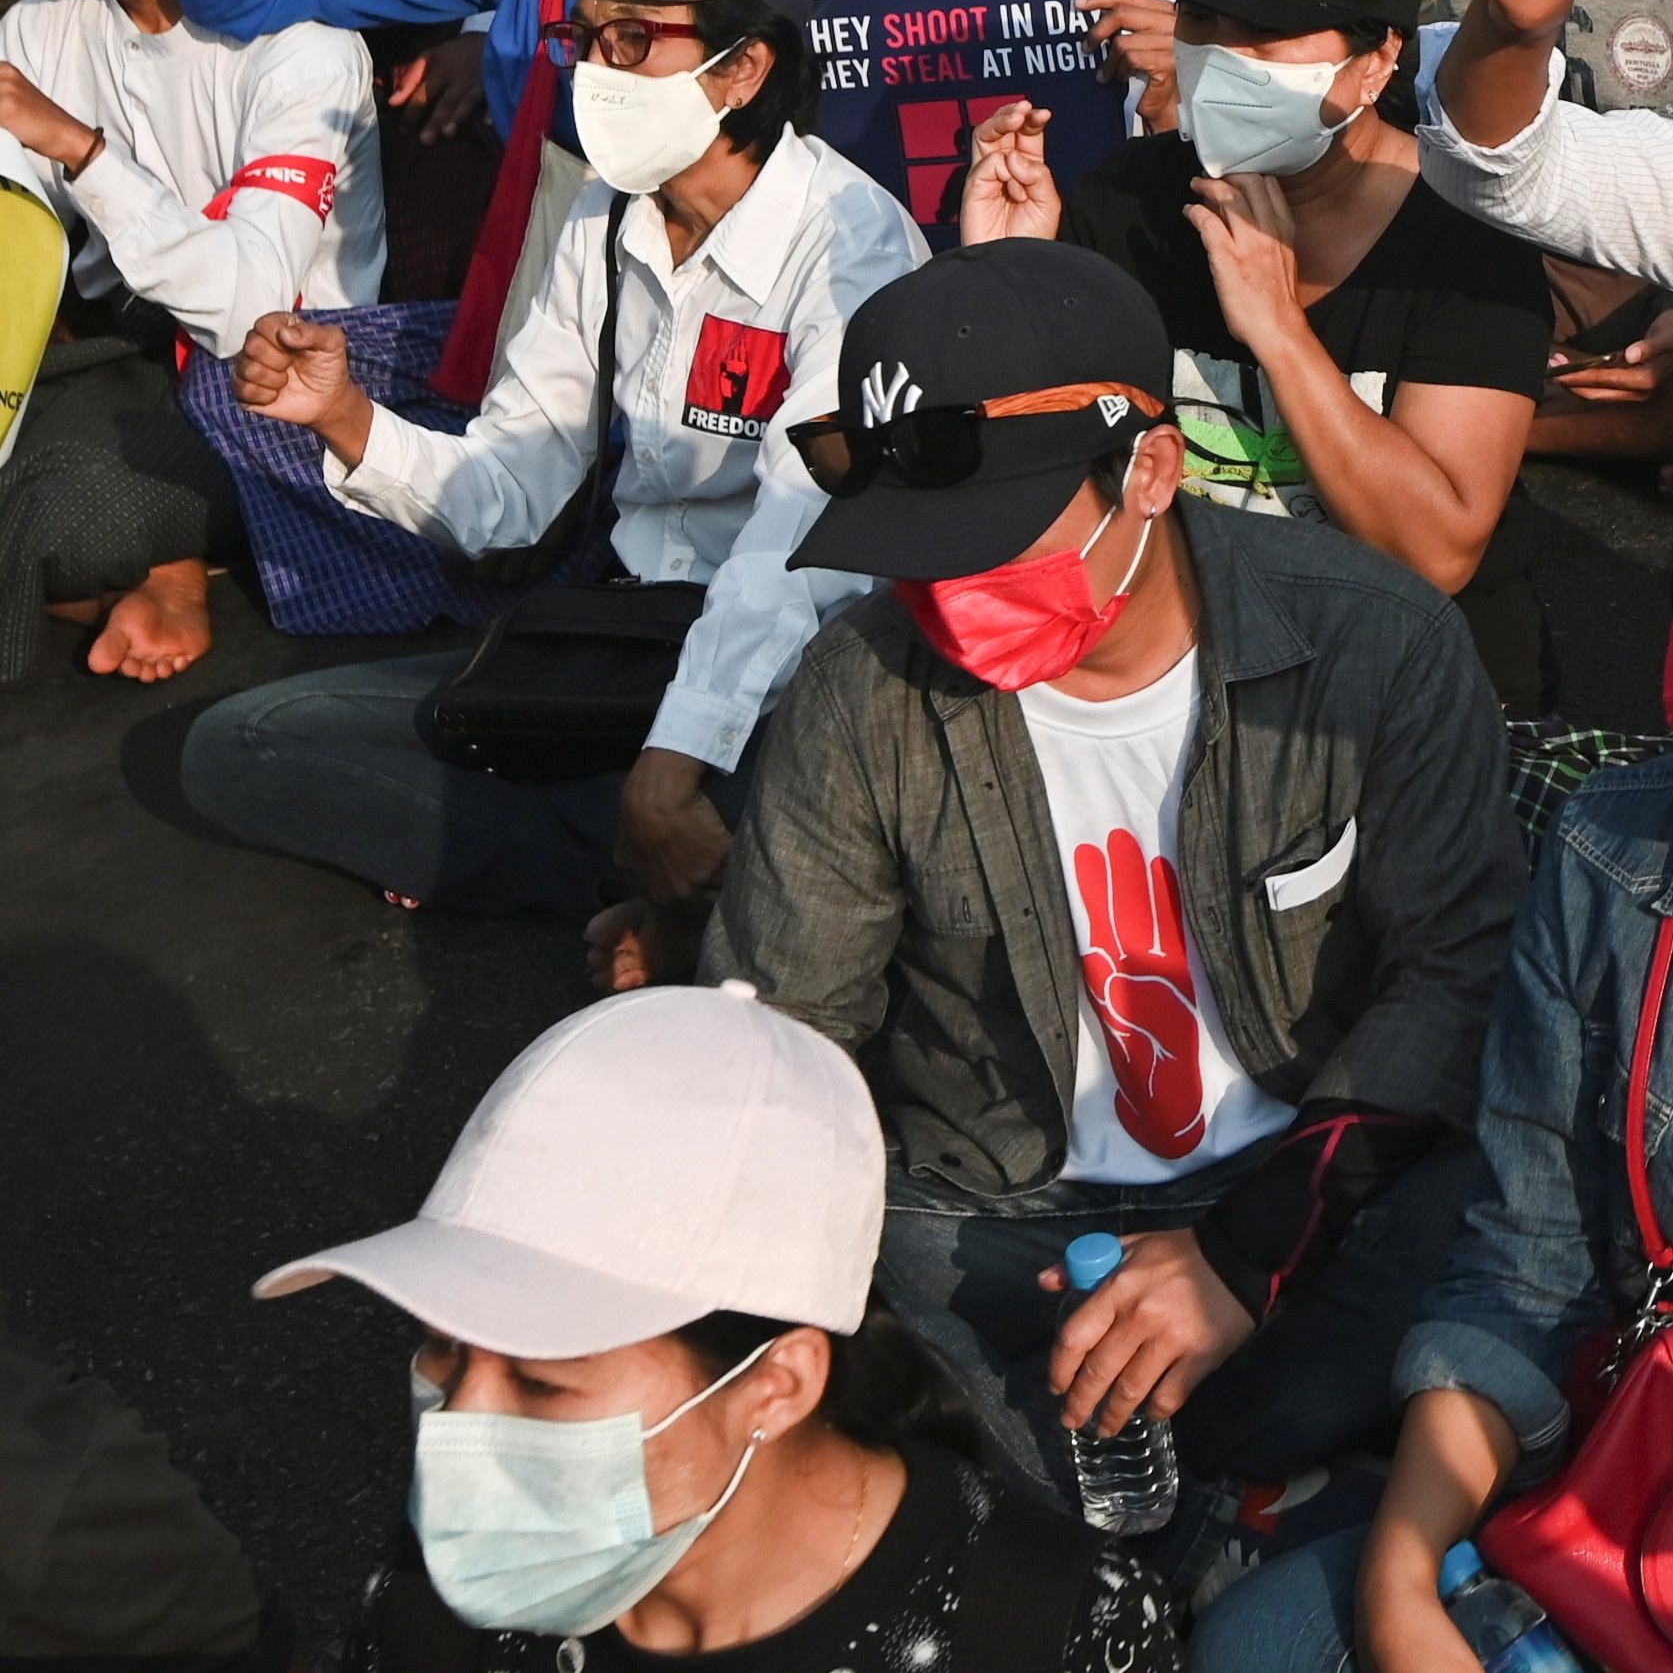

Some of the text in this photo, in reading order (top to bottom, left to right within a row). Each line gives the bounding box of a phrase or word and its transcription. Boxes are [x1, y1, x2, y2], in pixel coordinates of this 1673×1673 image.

[806, 16, 872, 55] HEY
[882, 6, 989, 50] SHOOT
[1000, 2, 1035, 40] IN
[820, 57, 870, 91] HEY
[881, 52, 974, 87] STEAL
[982, 47, 1013, 79] AT
